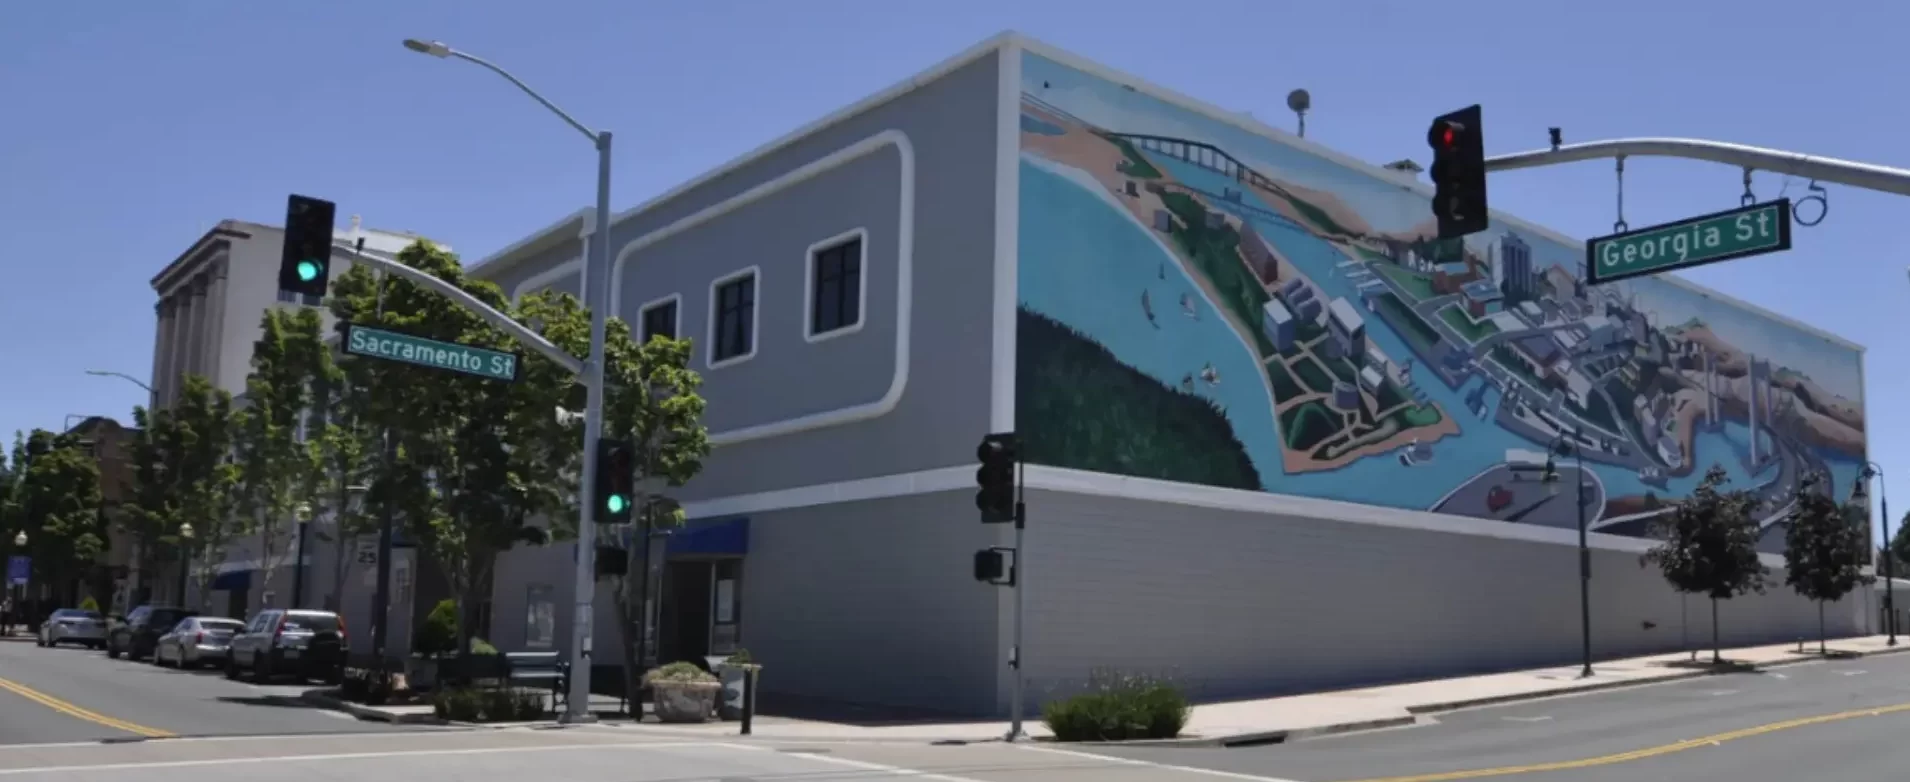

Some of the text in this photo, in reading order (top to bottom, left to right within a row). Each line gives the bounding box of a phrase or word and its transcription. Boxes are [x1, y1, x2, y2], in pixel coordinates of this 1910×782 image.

[1602, 211, 1769, 266] Georgia St
[352, 330, 513, 376] Sacramento St
[358, 551, 377, 564] 25
